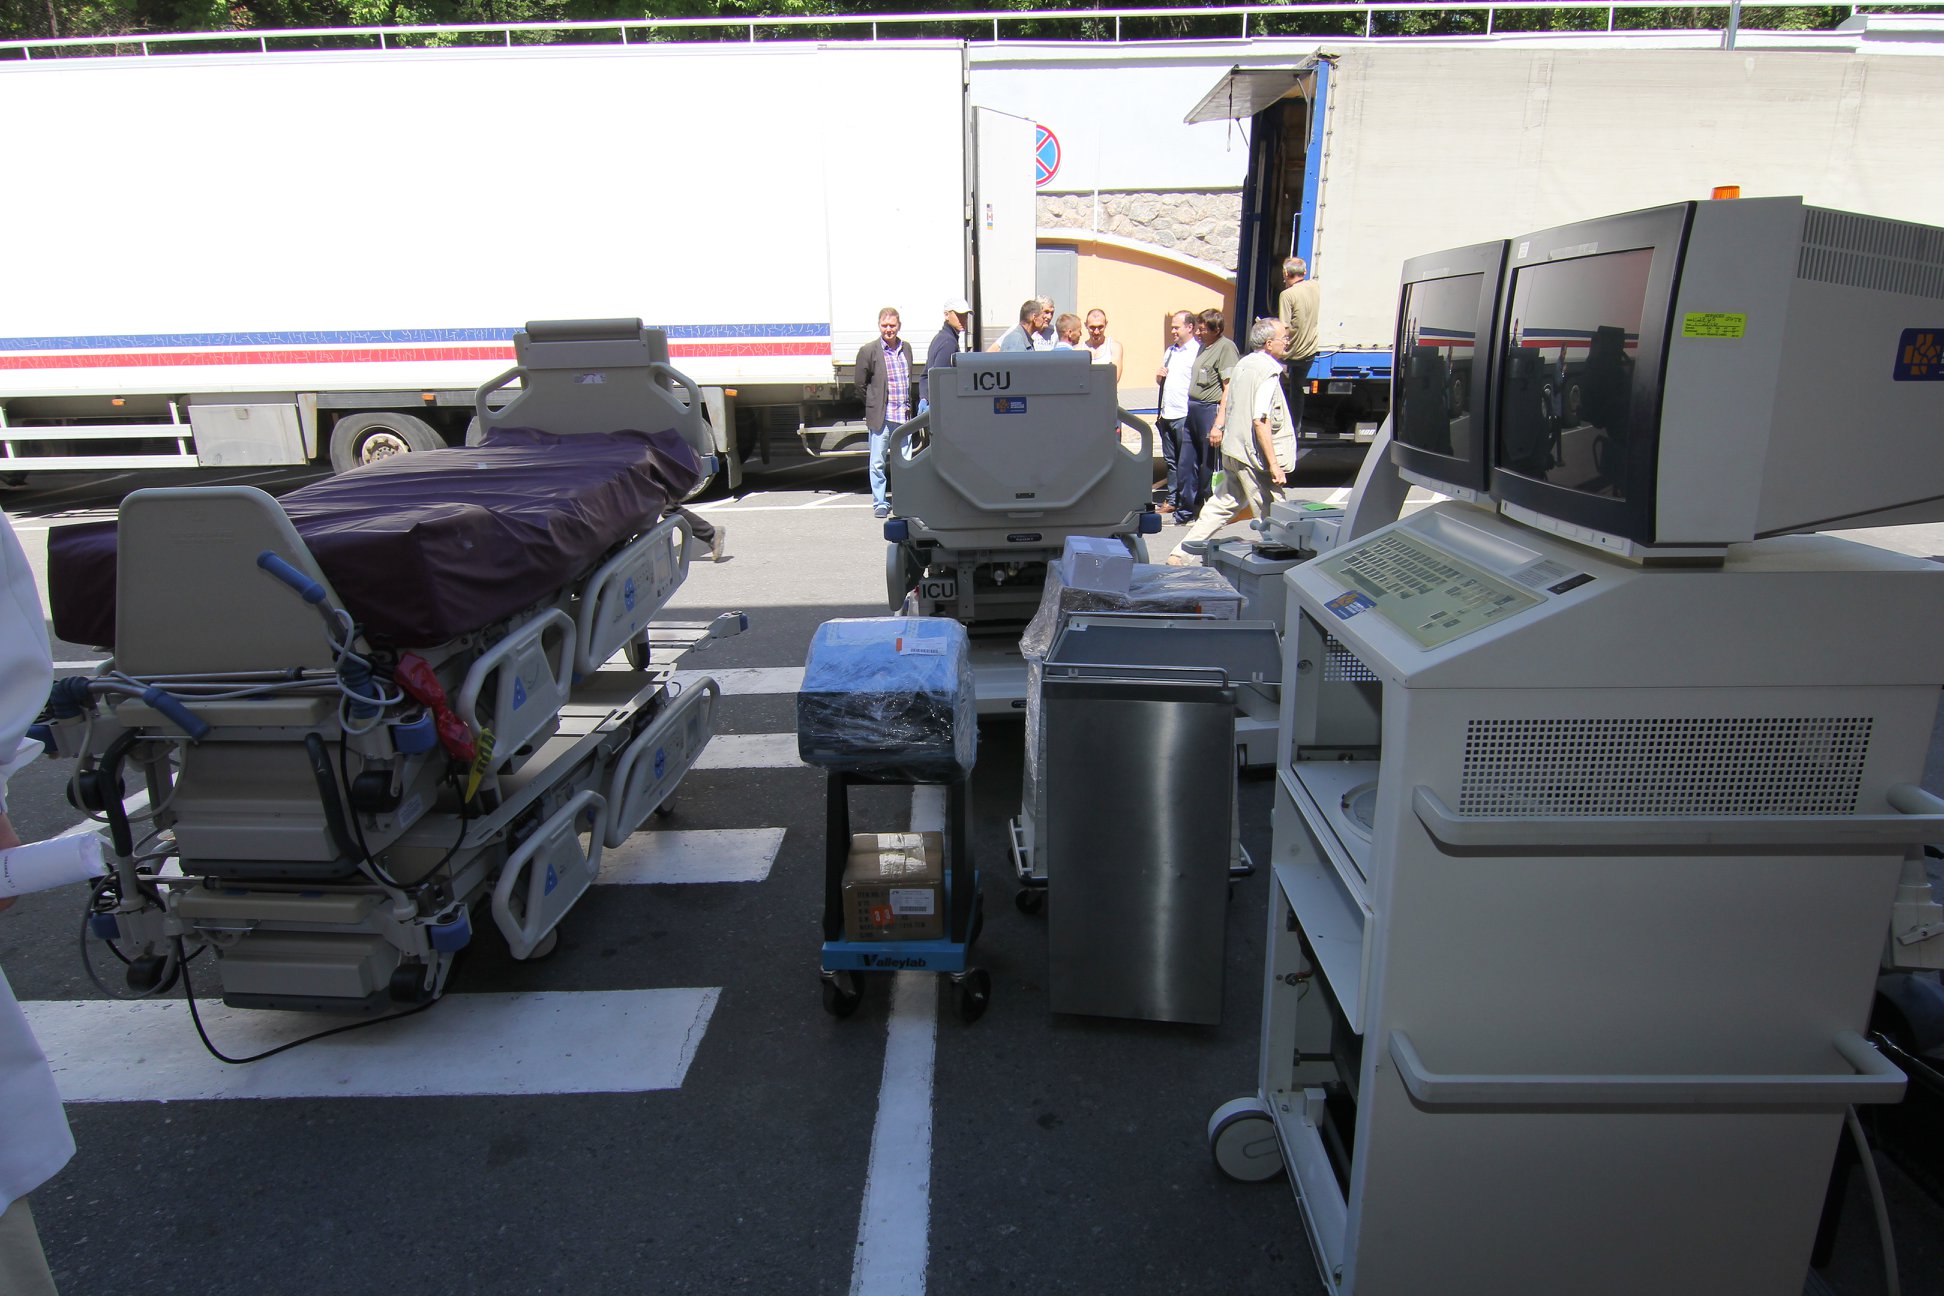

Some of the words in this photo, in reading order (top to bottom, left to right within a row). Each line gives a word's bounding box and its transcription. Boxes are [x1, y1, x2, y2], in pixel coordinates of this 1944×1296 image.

[973, 371, 1011, 391] ICU
[922, 583, 954, 599] ICU
[863, 954, 926, 969] Valleylab
